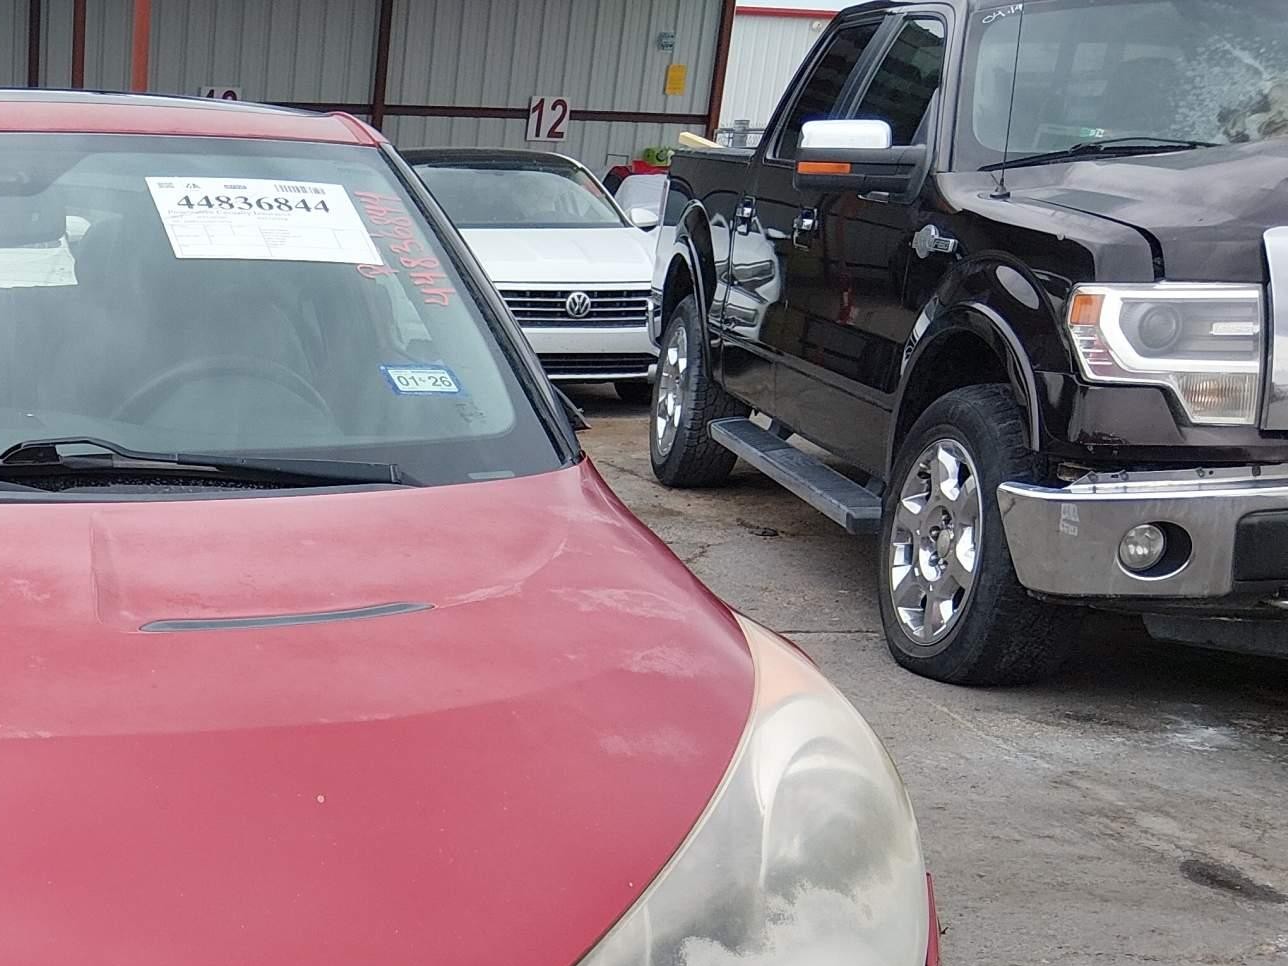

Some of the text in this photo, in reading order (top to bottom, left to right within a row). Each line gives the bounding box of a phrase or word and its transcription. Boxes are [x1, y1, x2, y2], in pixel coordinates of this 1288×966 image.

[531, 97, 568, 138] 12
[176, 194, 330, 214] 44836844
[396, 375, 452, 387] 01 26
